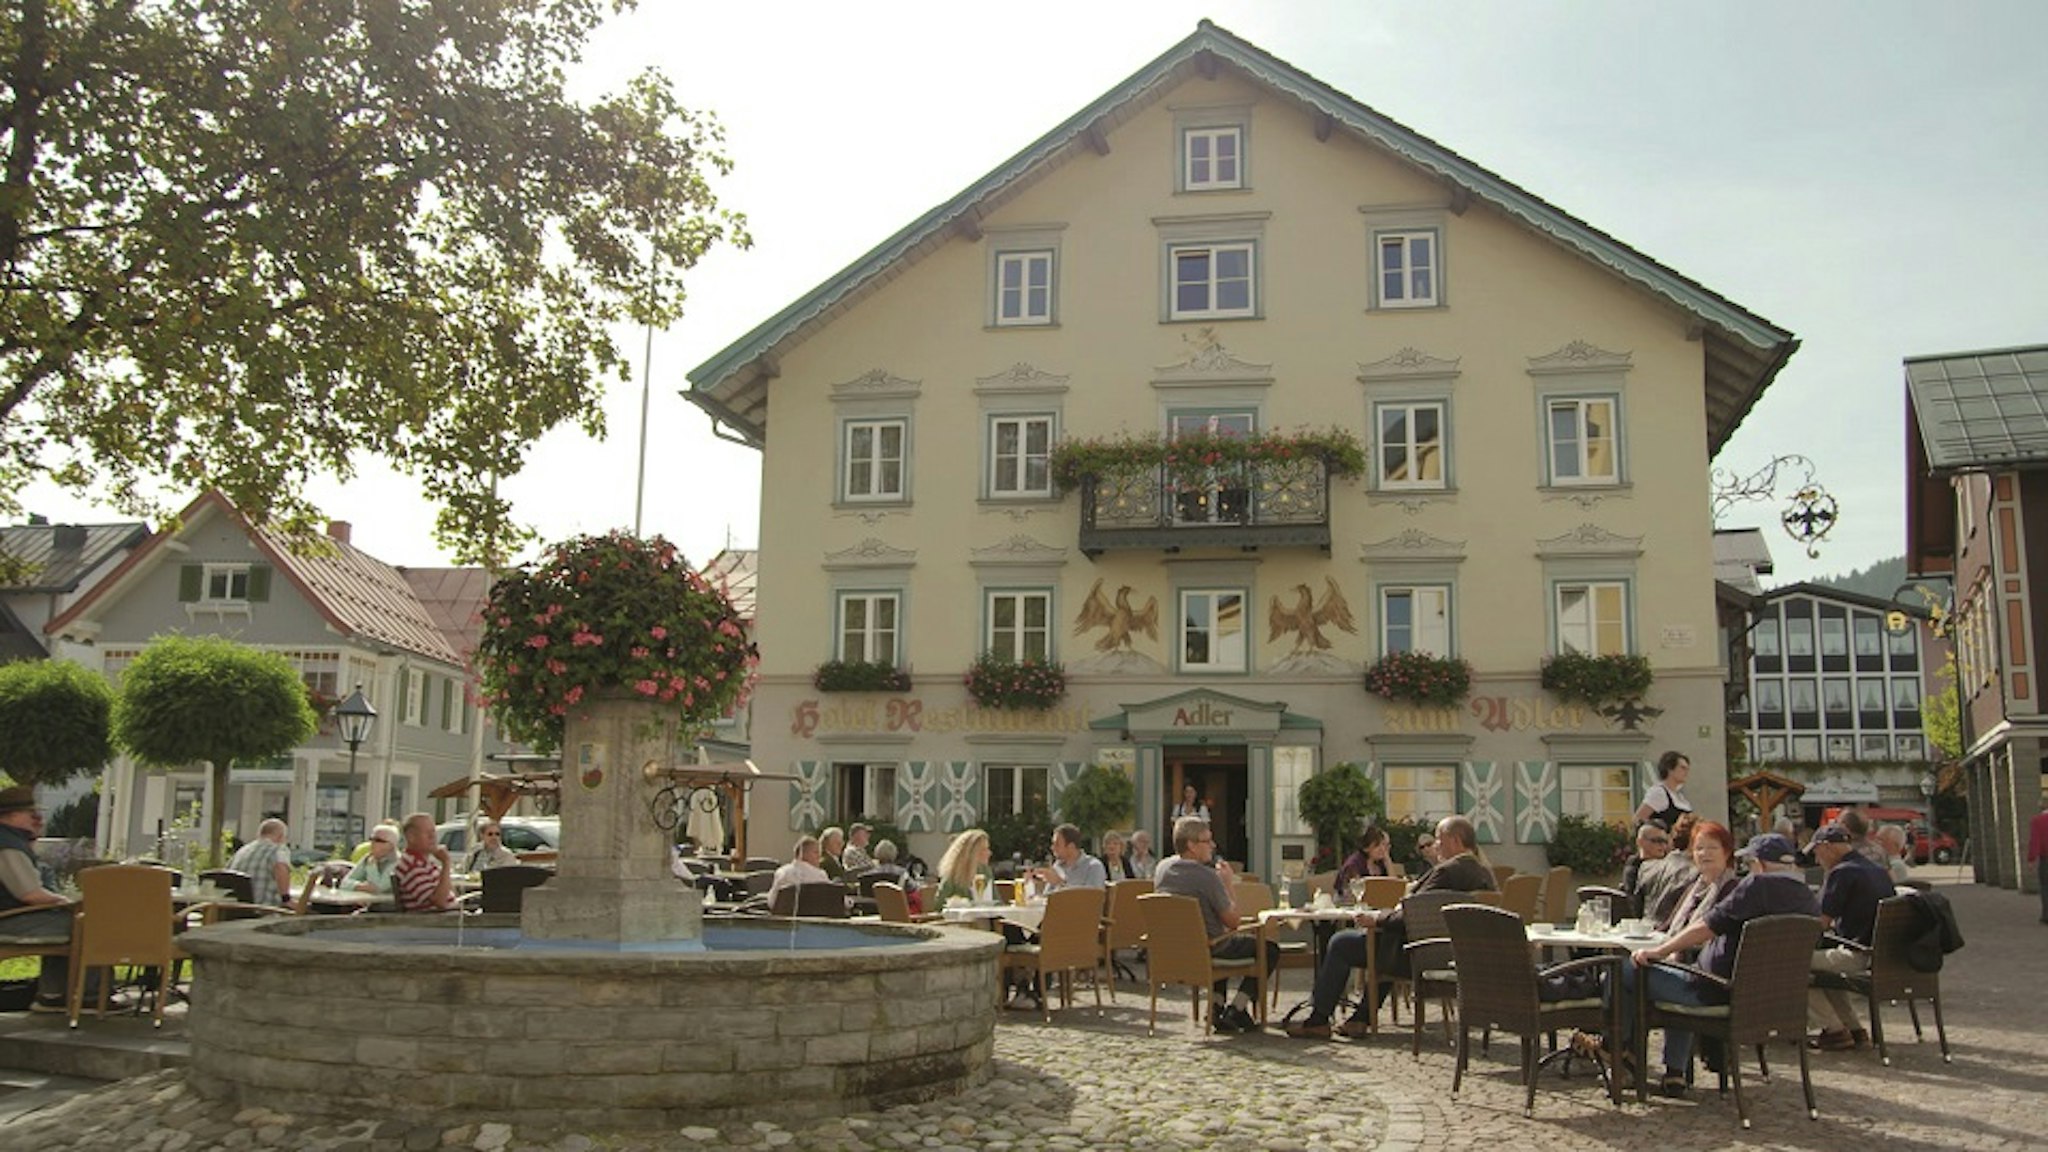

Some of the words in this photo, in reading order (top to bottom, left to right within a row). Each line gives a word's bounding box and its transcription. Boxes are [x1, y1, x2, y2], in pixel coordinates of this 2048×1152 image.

[790, 700, 877, 738] Hotel
[1173, 703, 1234, 726] Adler
[1471, 696, 1585, 732] Adler
